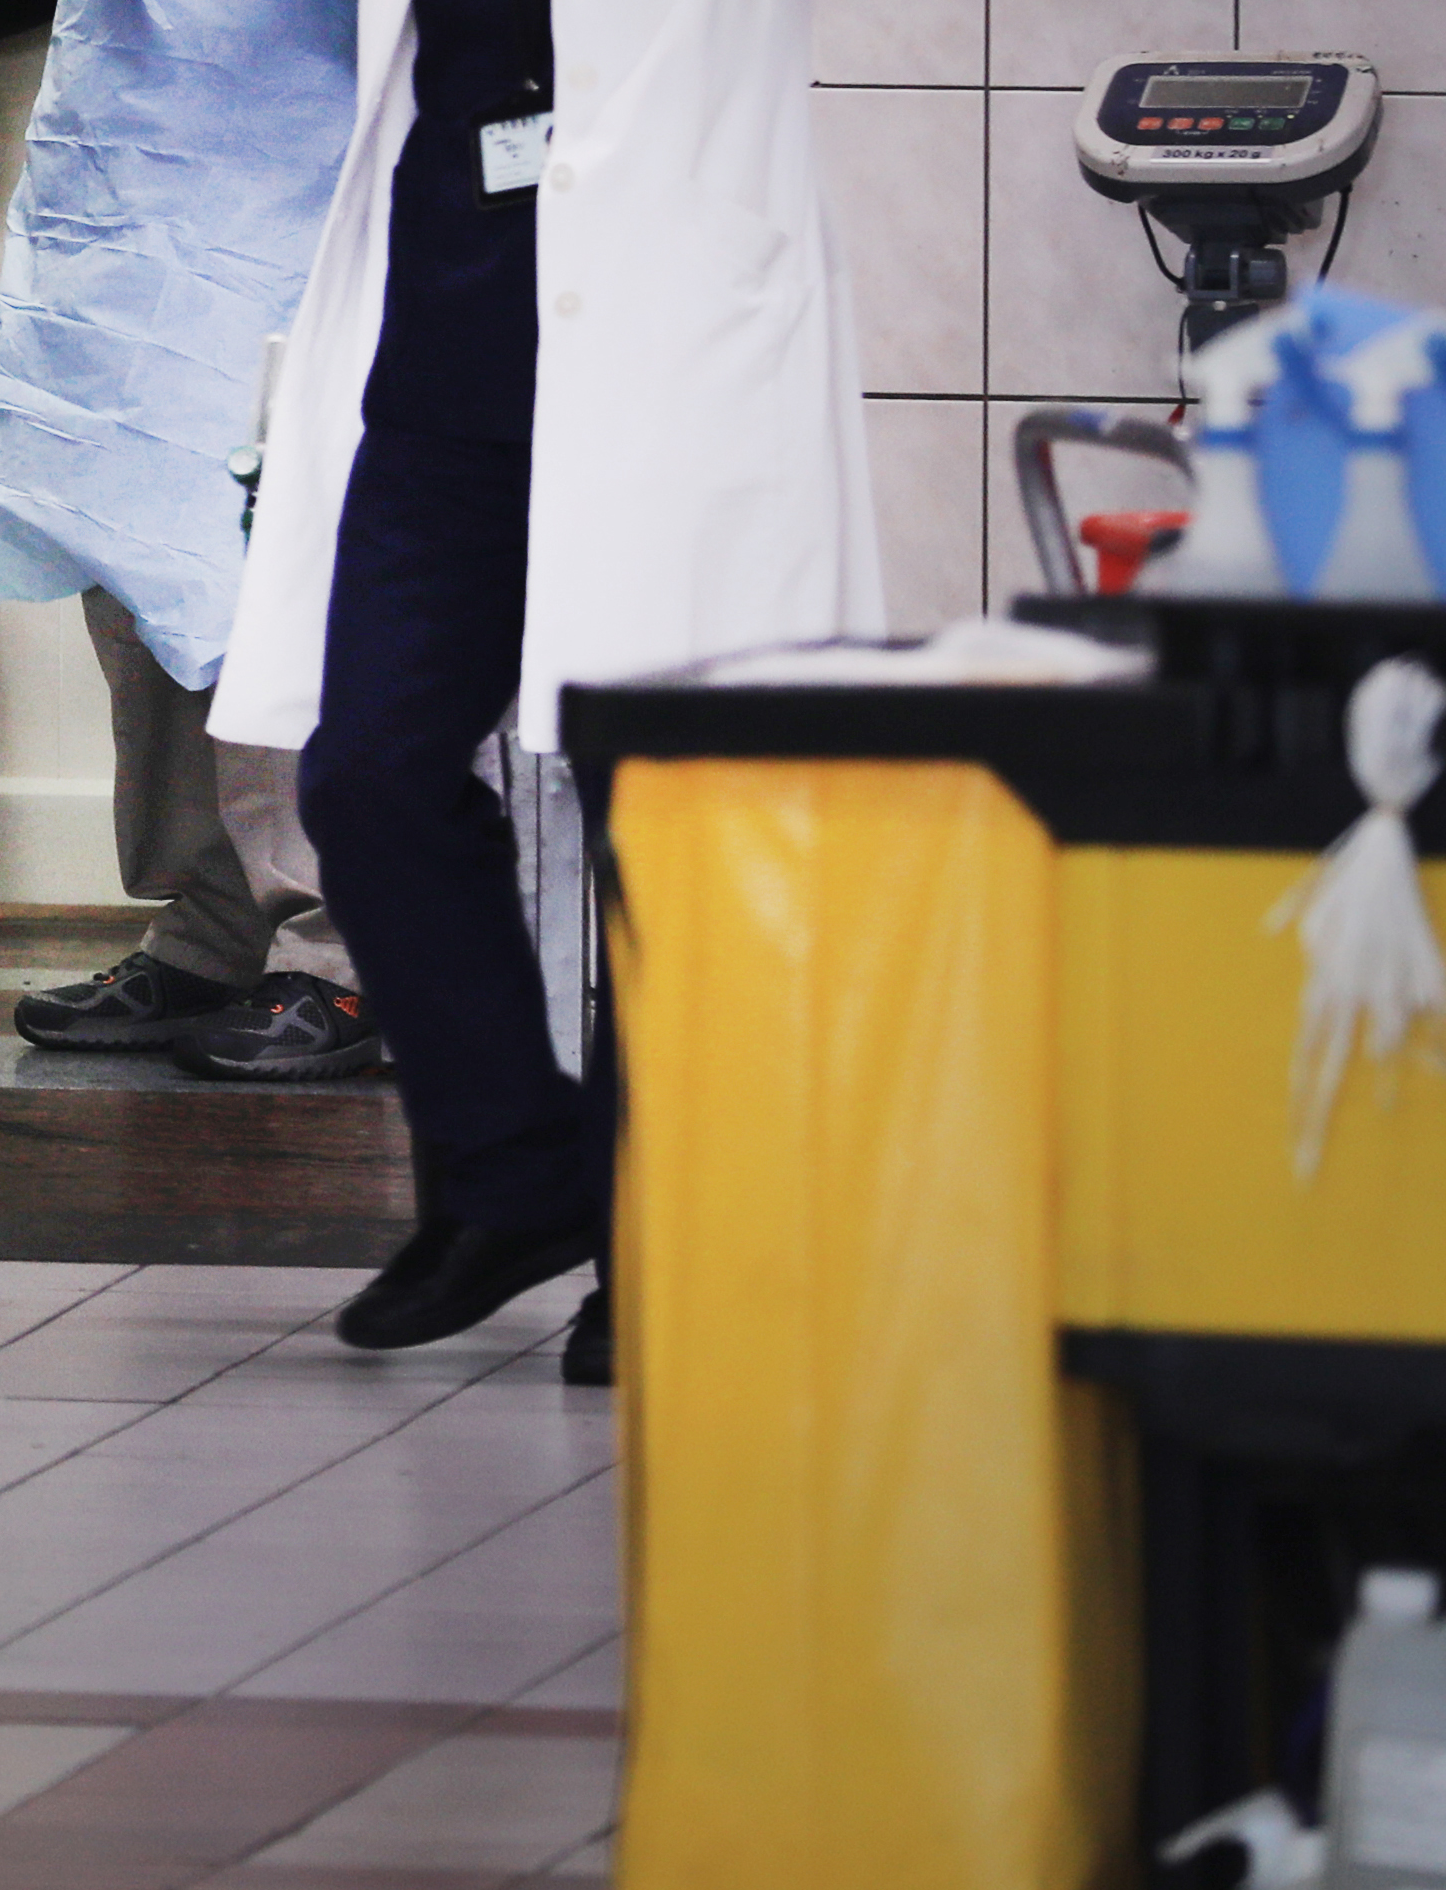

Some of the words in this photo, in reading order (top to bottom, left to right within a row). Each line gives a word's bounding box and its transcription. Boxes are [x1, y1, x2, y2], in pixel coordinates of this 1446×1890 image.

[1162, 149, 1191, 158] 300
[1194, 150, 1214, 159] kg
[1228, 149, 1249, 158] 20
[1251, 151, 1261, 159] g
